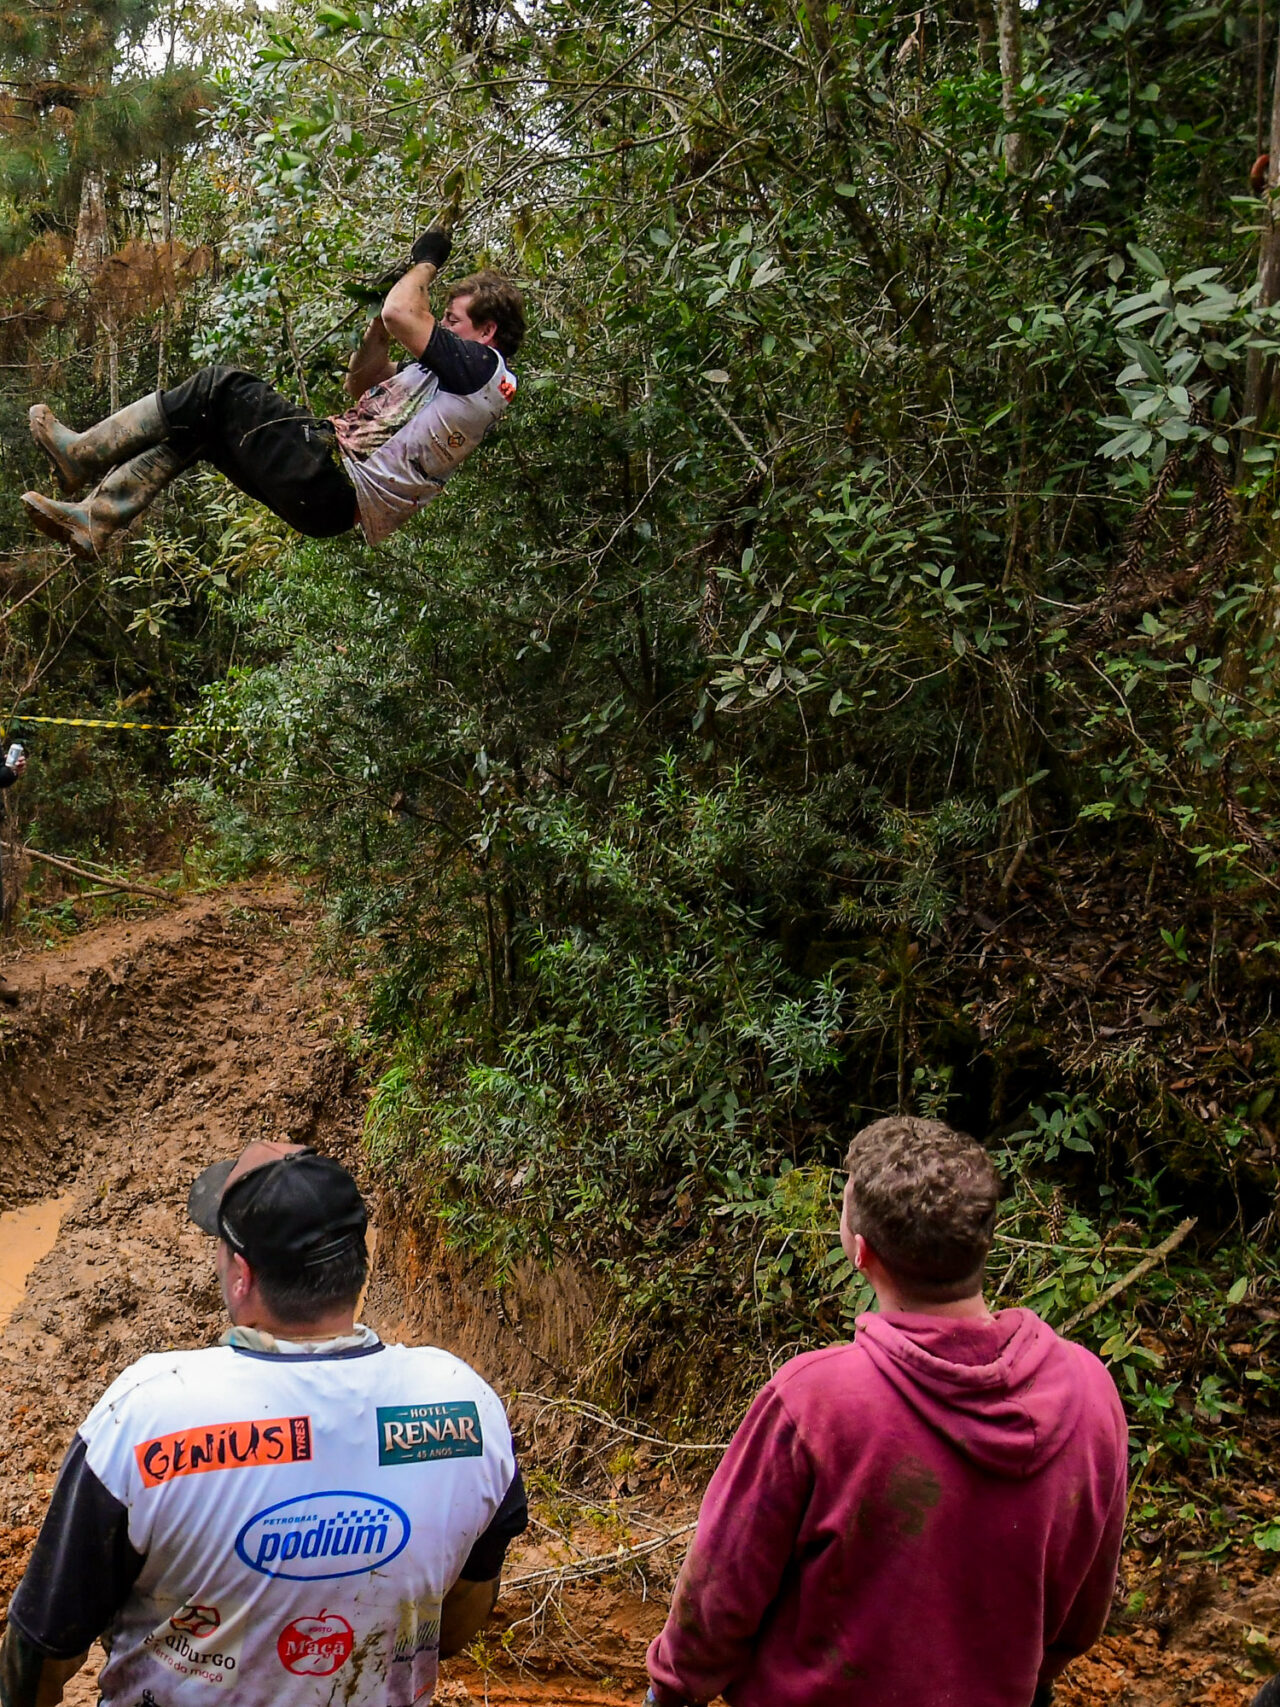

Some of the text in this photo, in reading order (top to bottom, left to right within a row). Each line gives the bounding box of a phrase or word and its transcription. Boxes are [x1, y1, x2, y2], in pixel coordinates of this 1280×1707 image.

[410, 1405, 449, 1418] HOTEL
[294, 1419, 307, 1458] TYRES
[383, 1416, 480, 1451] RENAR
[429, 1447, 453, 1458] ANOS
[262, 1514, 318, 1526] PETROBRAS
[255, 1519, 389, 1568] podium
[285, 1640, 345, 1659] Maçã
[173, 1661, 188, 1674] da
